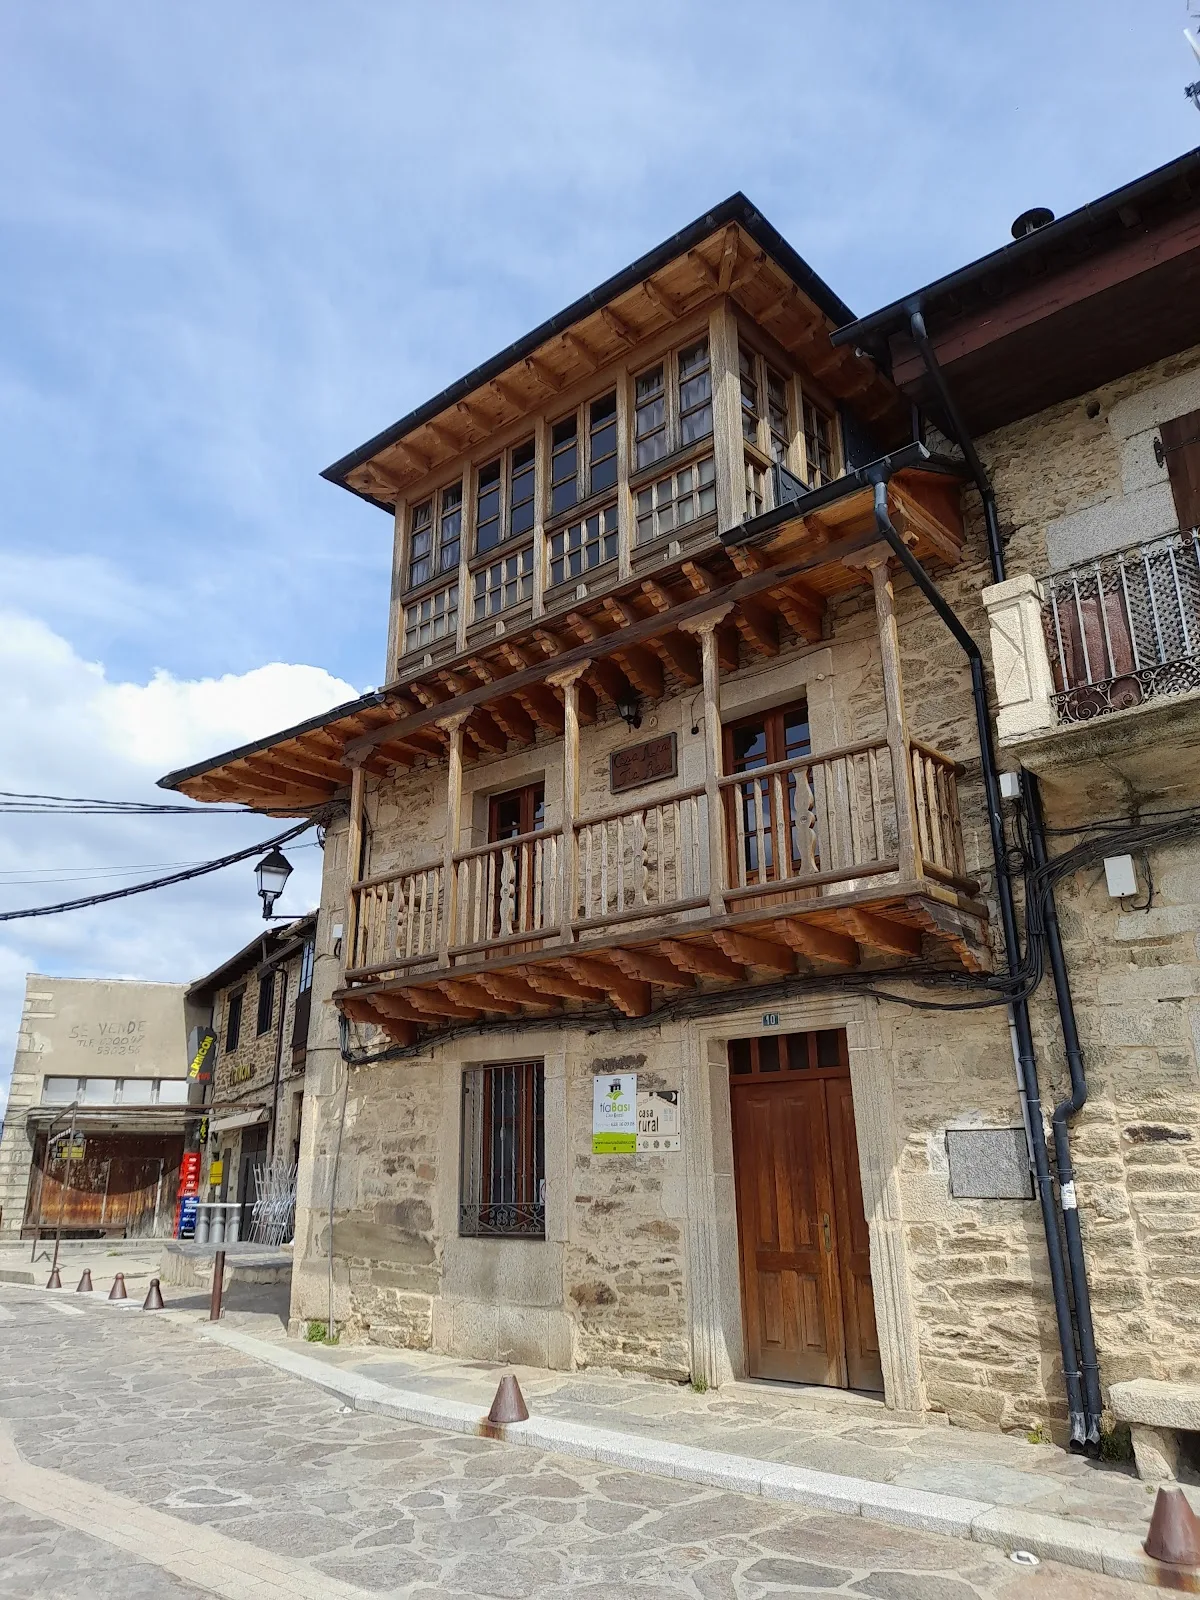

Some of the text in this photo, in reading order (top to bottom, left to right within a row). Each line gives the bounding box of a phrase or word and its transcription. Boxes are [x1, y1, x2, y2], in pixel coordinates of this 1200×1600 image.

[765, 1014, 776, 1025] 10
[68, 1020, 147, 1039] SE VENDE
[191, 1035, 213, 1067] RINCÓN
[639, 1109, 654, 1118] casa
[639, 1116, 659, 1132] rural
